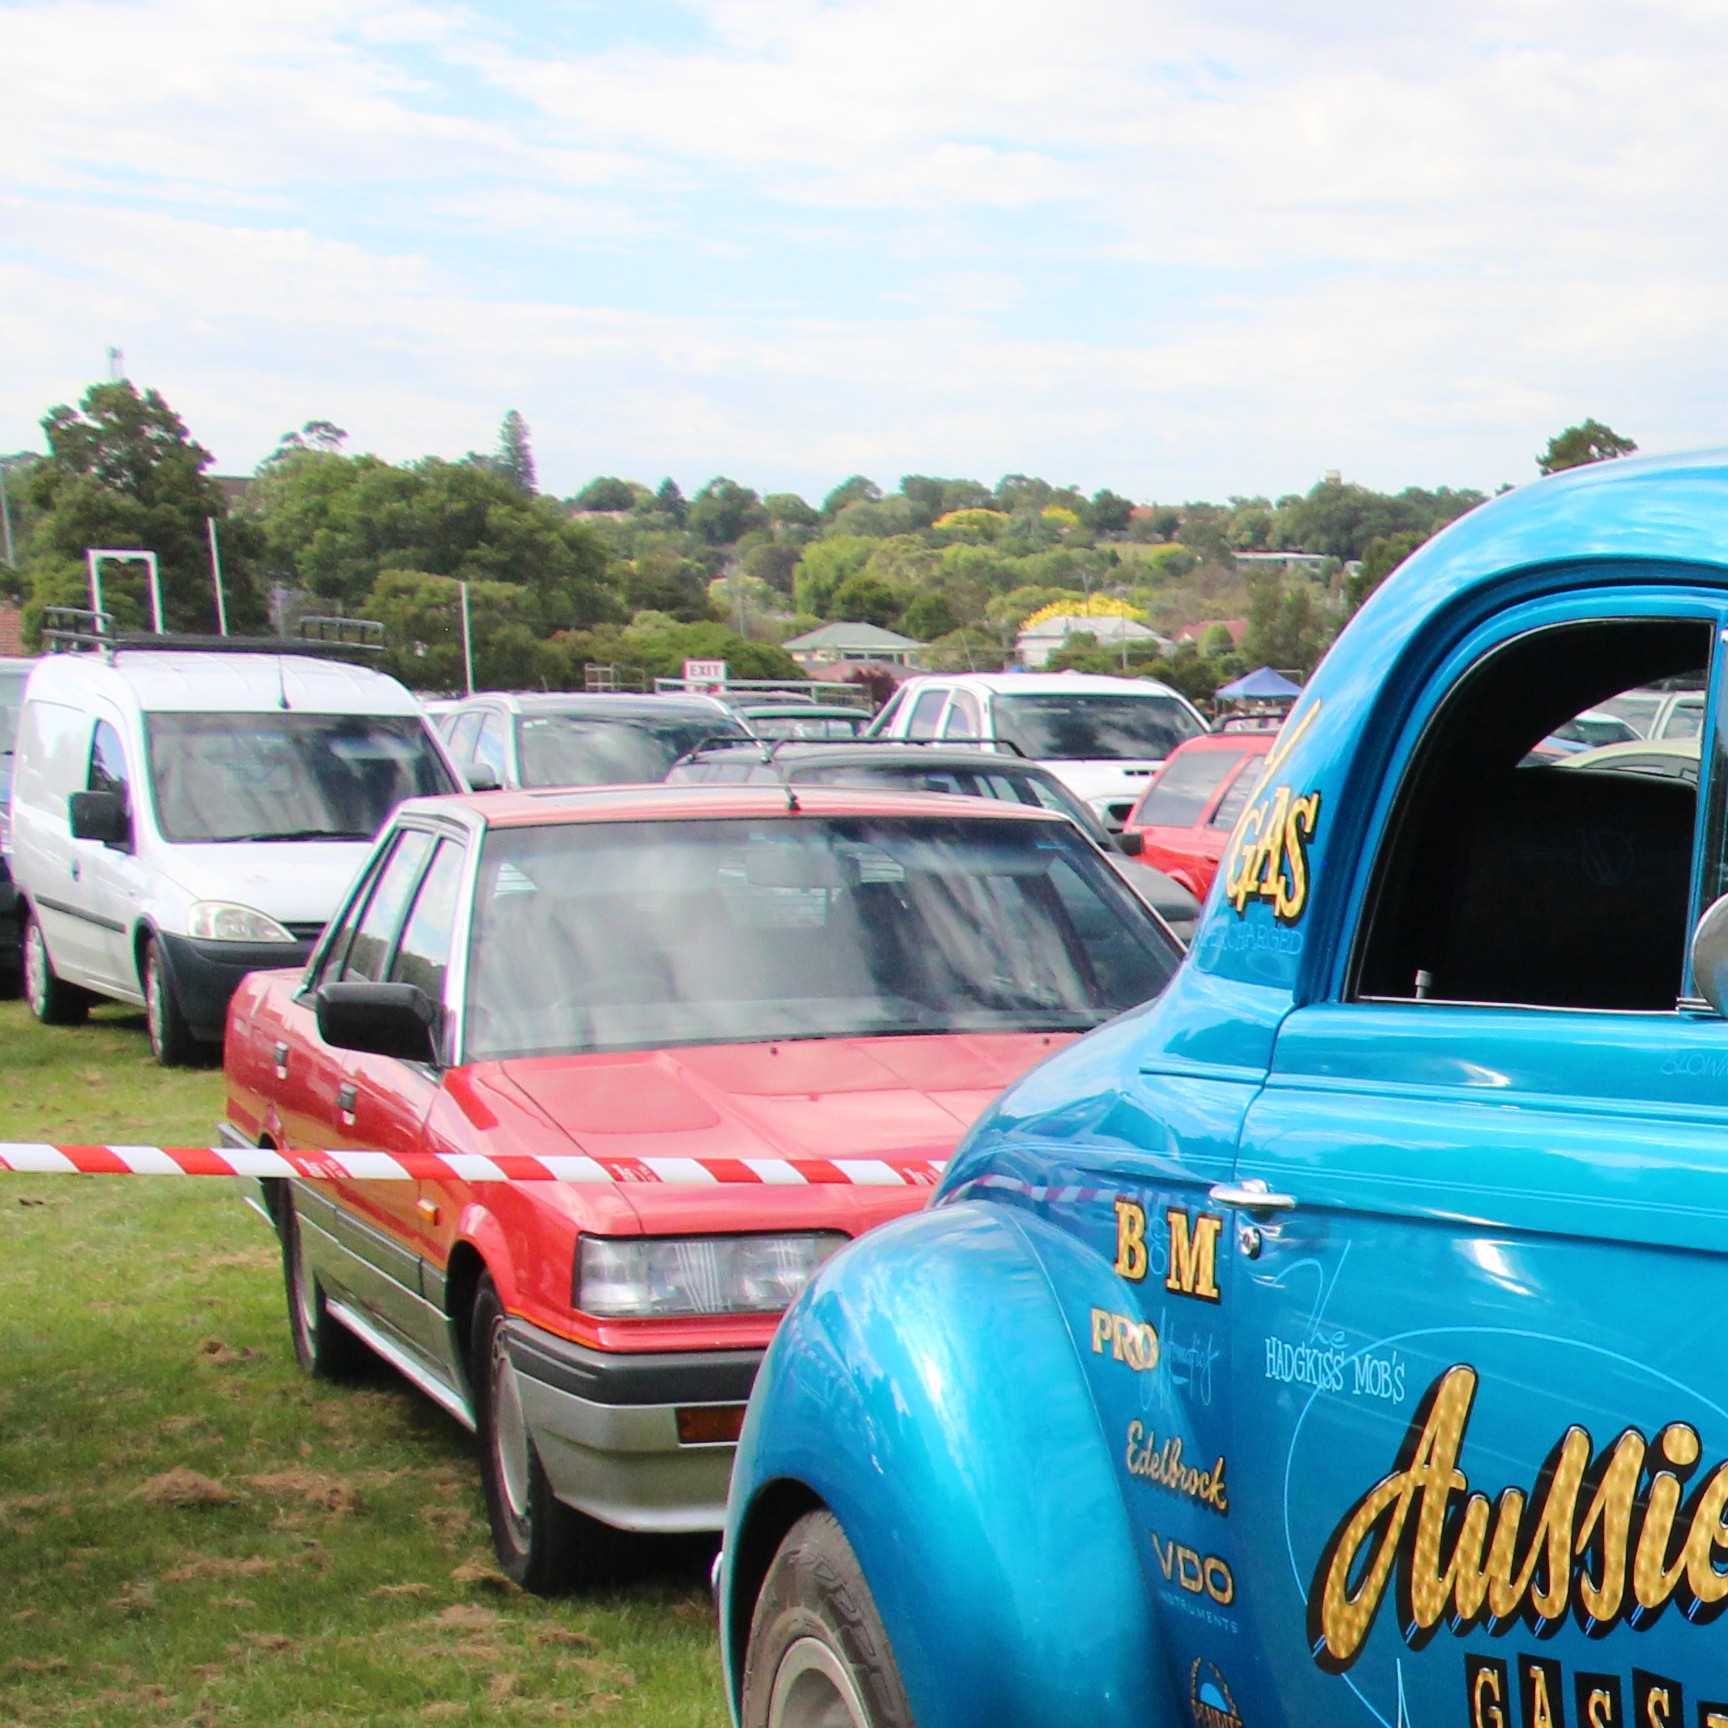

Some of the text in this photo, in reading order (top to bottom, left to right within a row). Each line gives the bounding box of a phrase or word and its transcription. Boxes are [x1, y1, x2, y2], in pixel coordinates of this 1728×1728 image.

[689, 665, 721, 676] EXIT
[1090, 1306, 1159, 1372] PRO
[1351, 1351, 1406, 1405] MOB'S
[1126, 1418, 1228, 1513] Edelbrock
[1151, 1530, 1233, 1605] VDO
